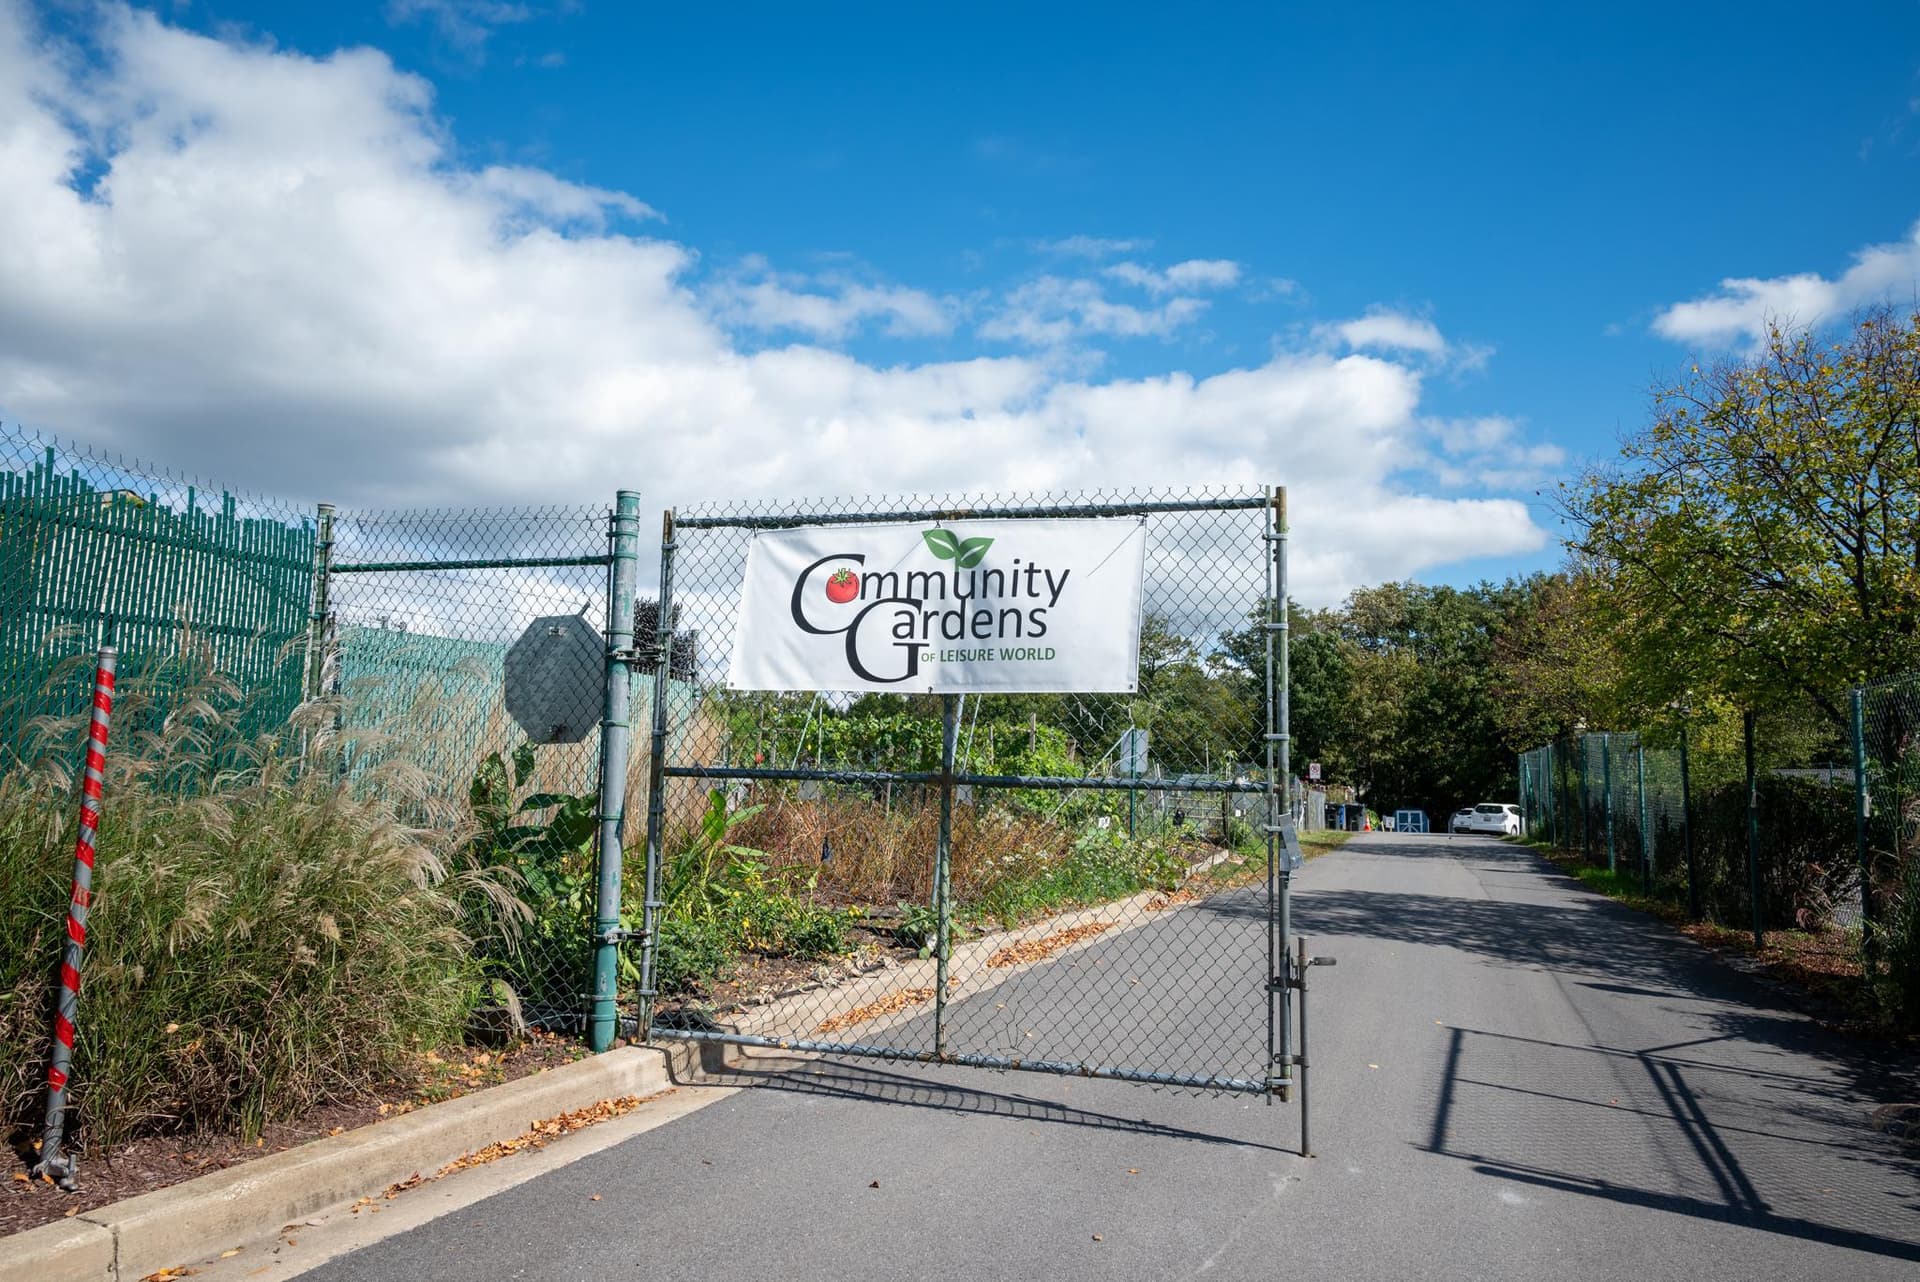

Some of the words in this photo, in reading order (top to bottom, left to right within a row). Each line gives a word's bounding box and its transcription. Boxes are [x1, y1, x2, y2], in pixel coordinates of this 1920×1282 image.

[791, 553, 1071, 635] Community
[845, 597, 1048, 683] Gardens
[921, 652, 936, 663] OF
[940, 648, 995, 662] LEISURE
[1000, 647, 1056, 661] WORLD
